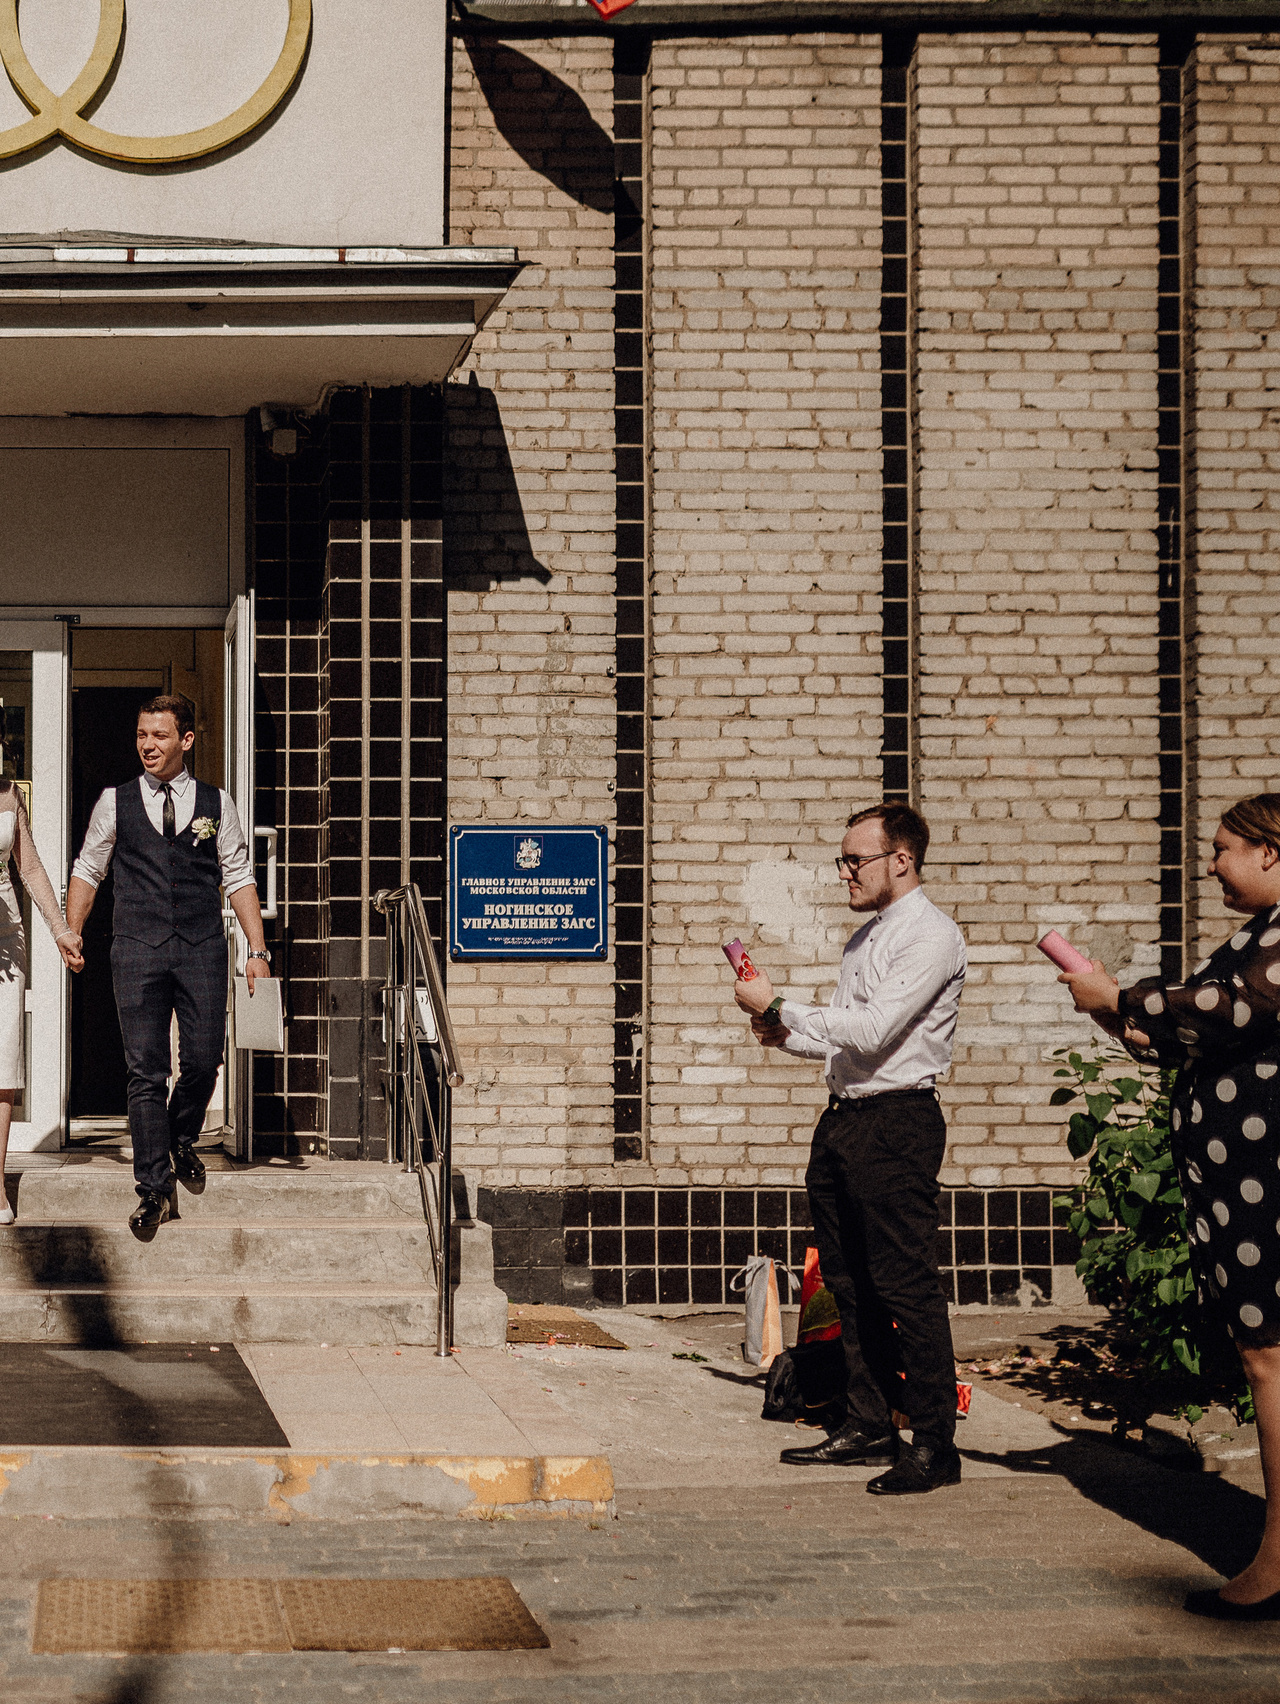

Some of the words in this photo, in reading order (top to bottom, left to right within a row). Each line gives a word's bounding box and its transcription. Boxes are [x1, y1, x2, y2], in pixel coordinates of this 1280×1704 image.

[461, 878, 505, 886] ГЛАВНОЕ
[508, 878, 570, 886] УПРАВЛЕНИЕ
[573, 878, 596, 886] ЗАГС
[470, 886, 540, 895] МОСКОВСКОЙ
[542, 887, 587, 895] ОБЛАСТИ
[484, 904, 574, 915] НОГИНСКОЕ
[461, 918, 558, 929] УПРАВЛЕНИЕ
[561, 918, 595, 929] ЗАГС
